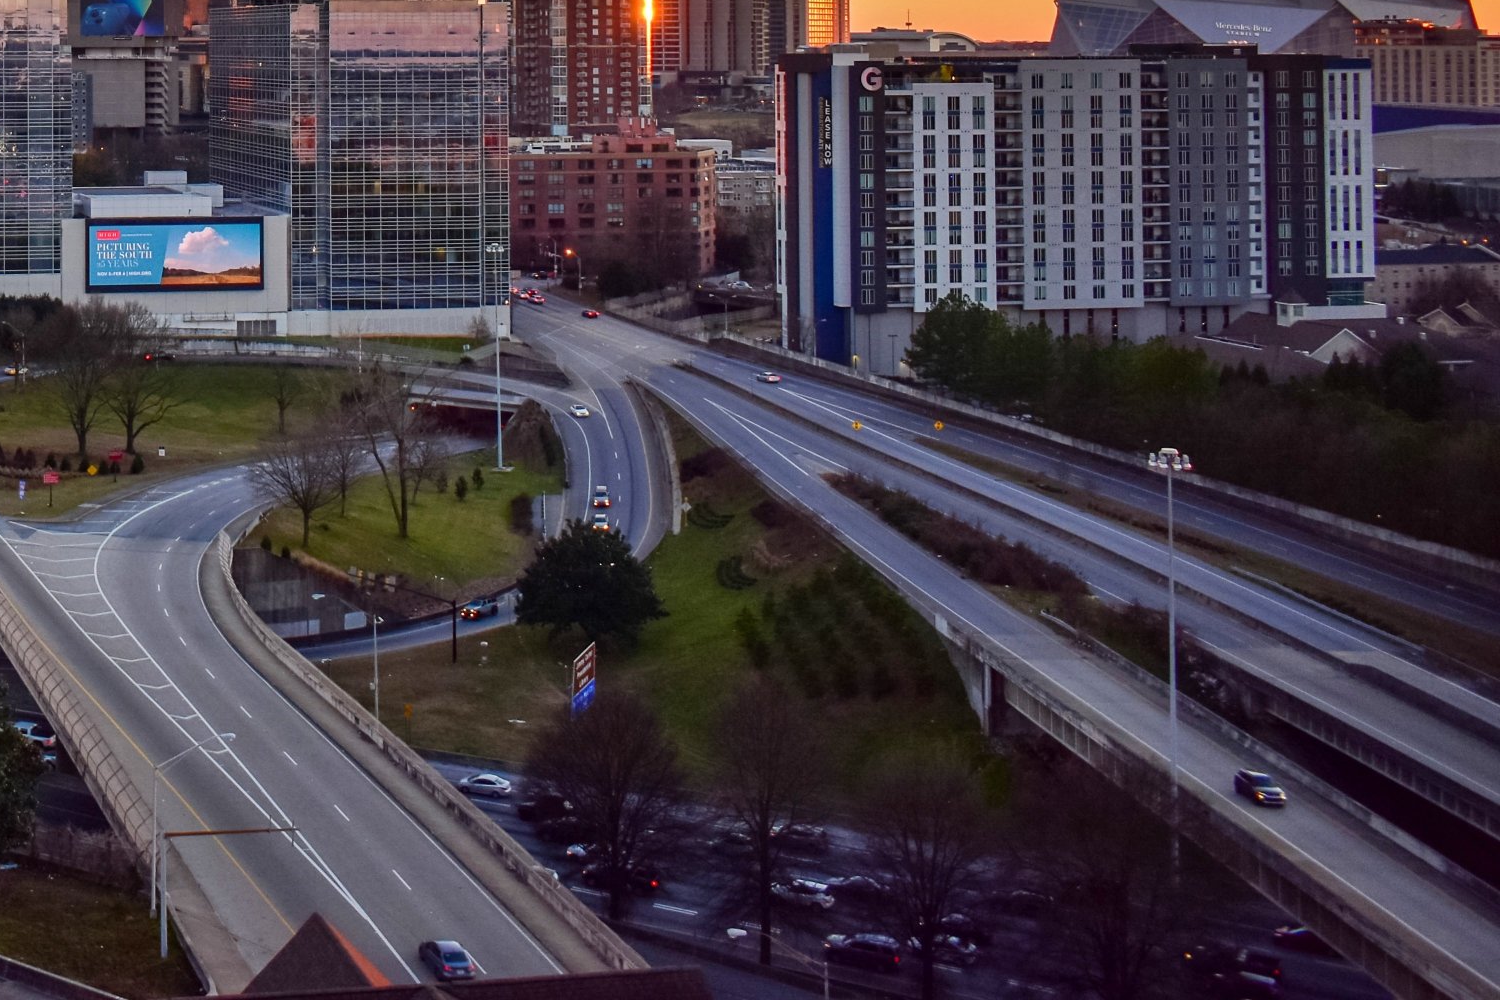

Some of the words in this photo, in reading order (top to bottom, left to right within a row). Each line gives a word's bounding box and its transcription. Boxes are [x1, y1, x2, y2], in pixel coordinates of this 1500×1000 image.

[861, 66, 883, 91] G
[824, 143, 832, 165] NOW
[97, 243, 150, 251] PICTURING
[97, 251, 117, 259] THE
[119, 251, 152, 259] SOUTH
[107, 259, 139, 268] YEARS
